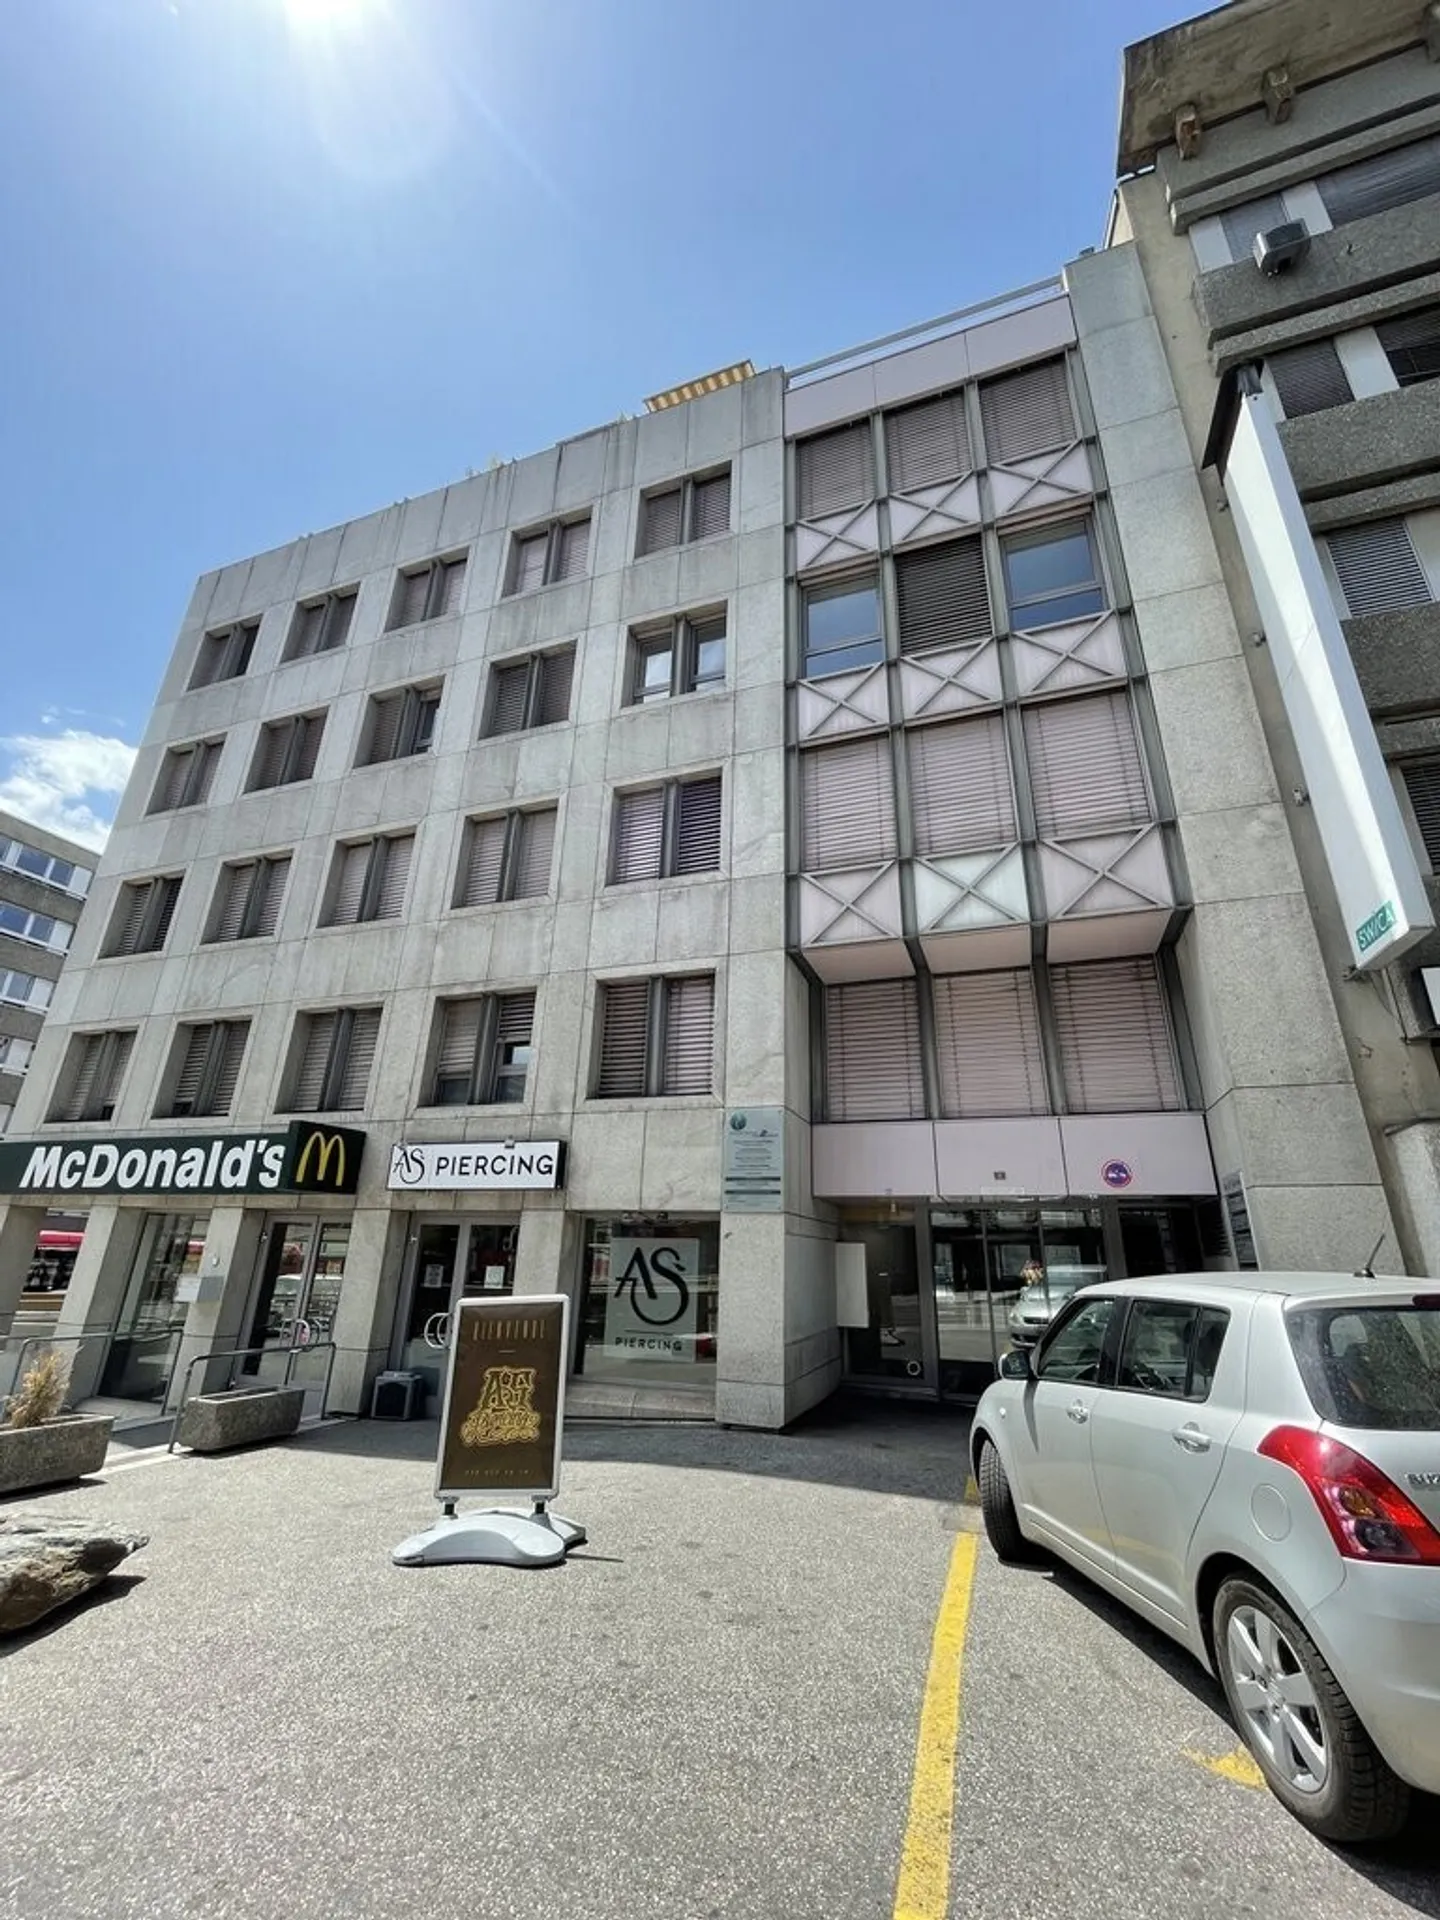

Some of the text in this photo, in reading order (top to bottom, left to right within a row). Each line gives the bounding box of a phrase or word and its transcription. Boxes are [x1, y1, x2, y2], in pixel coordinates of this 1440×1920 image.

[1357, 906, 1395, 949] SWICA
[19, 1139, 287, 1190] McDonald's
[392, 1147, 554, 1185] AS PIERCING
[613, 1246, 690, 1326] AS
[614, 1336, 683, 1352] PIERCING
